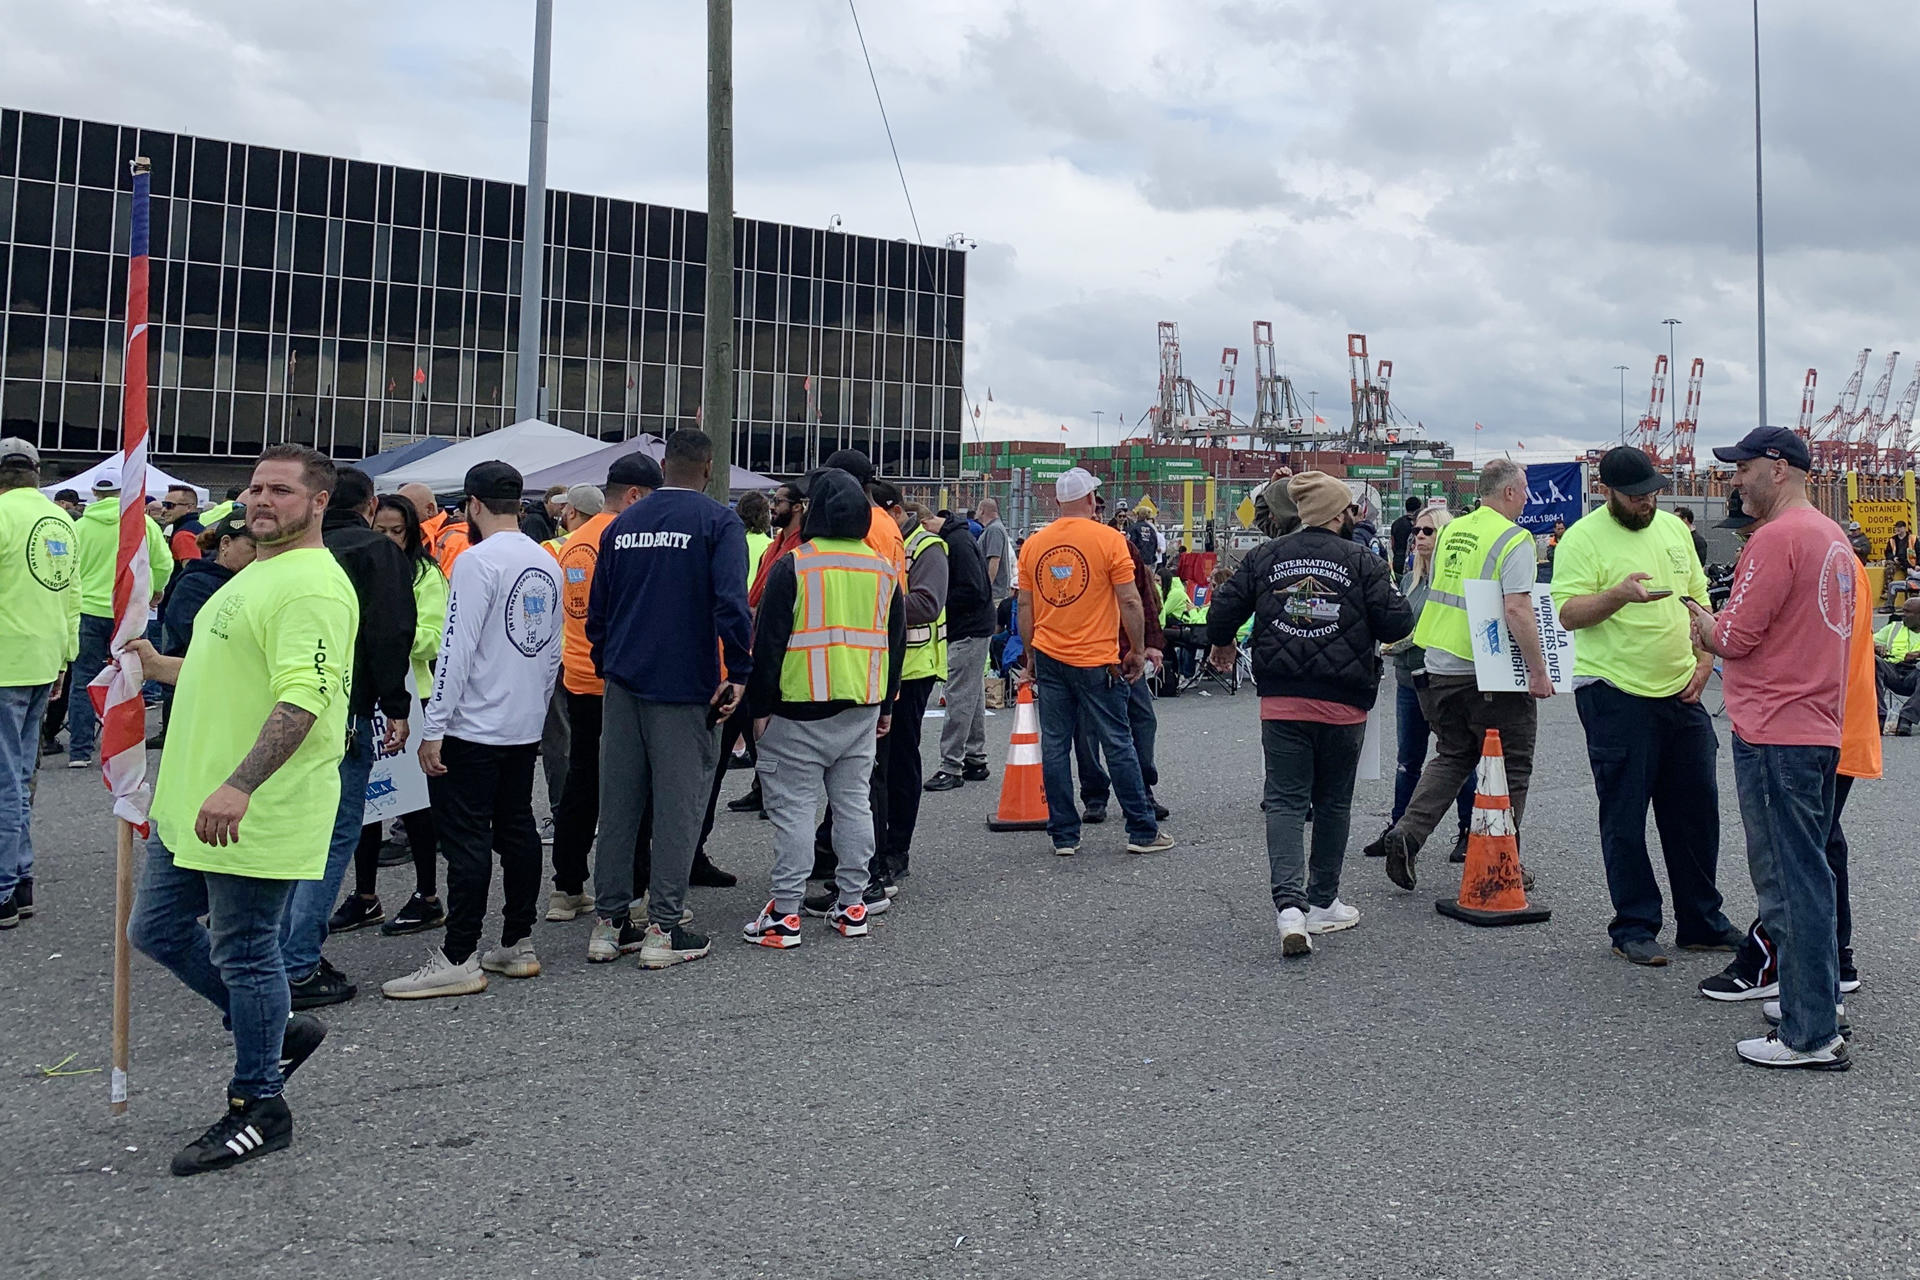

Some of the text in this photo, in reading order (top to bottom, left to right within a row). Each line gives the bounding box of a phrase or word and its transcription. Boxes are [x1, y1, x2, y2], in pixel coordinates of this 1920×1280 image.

[1032, 457, 1071, 466] EVERGREEN
[1517, 513, 1564, 524] OCAL 1804-1
[1858, 505, 1903, 513] CONTAINER
[1867, 516, 1894, 524] DOORS
[1865, 526, 1885, 534] MUST
[1268, 567, 1352, 588] LONGSHOREMEN'S
[1273, 559, 1350, 577] INTERNATIONAL
[1729, 559, 1756, 615] LOCAL
[1271, 619, 1340, 638] ASSOCIATION
[435, 591, 458, 702] LOCAL 1235
[1540, 595, 1561, 683] WORKERS OVER
[1556, 629, 1568, 648] ILA
[1510, 644, 1526, 687] RIGHTS
